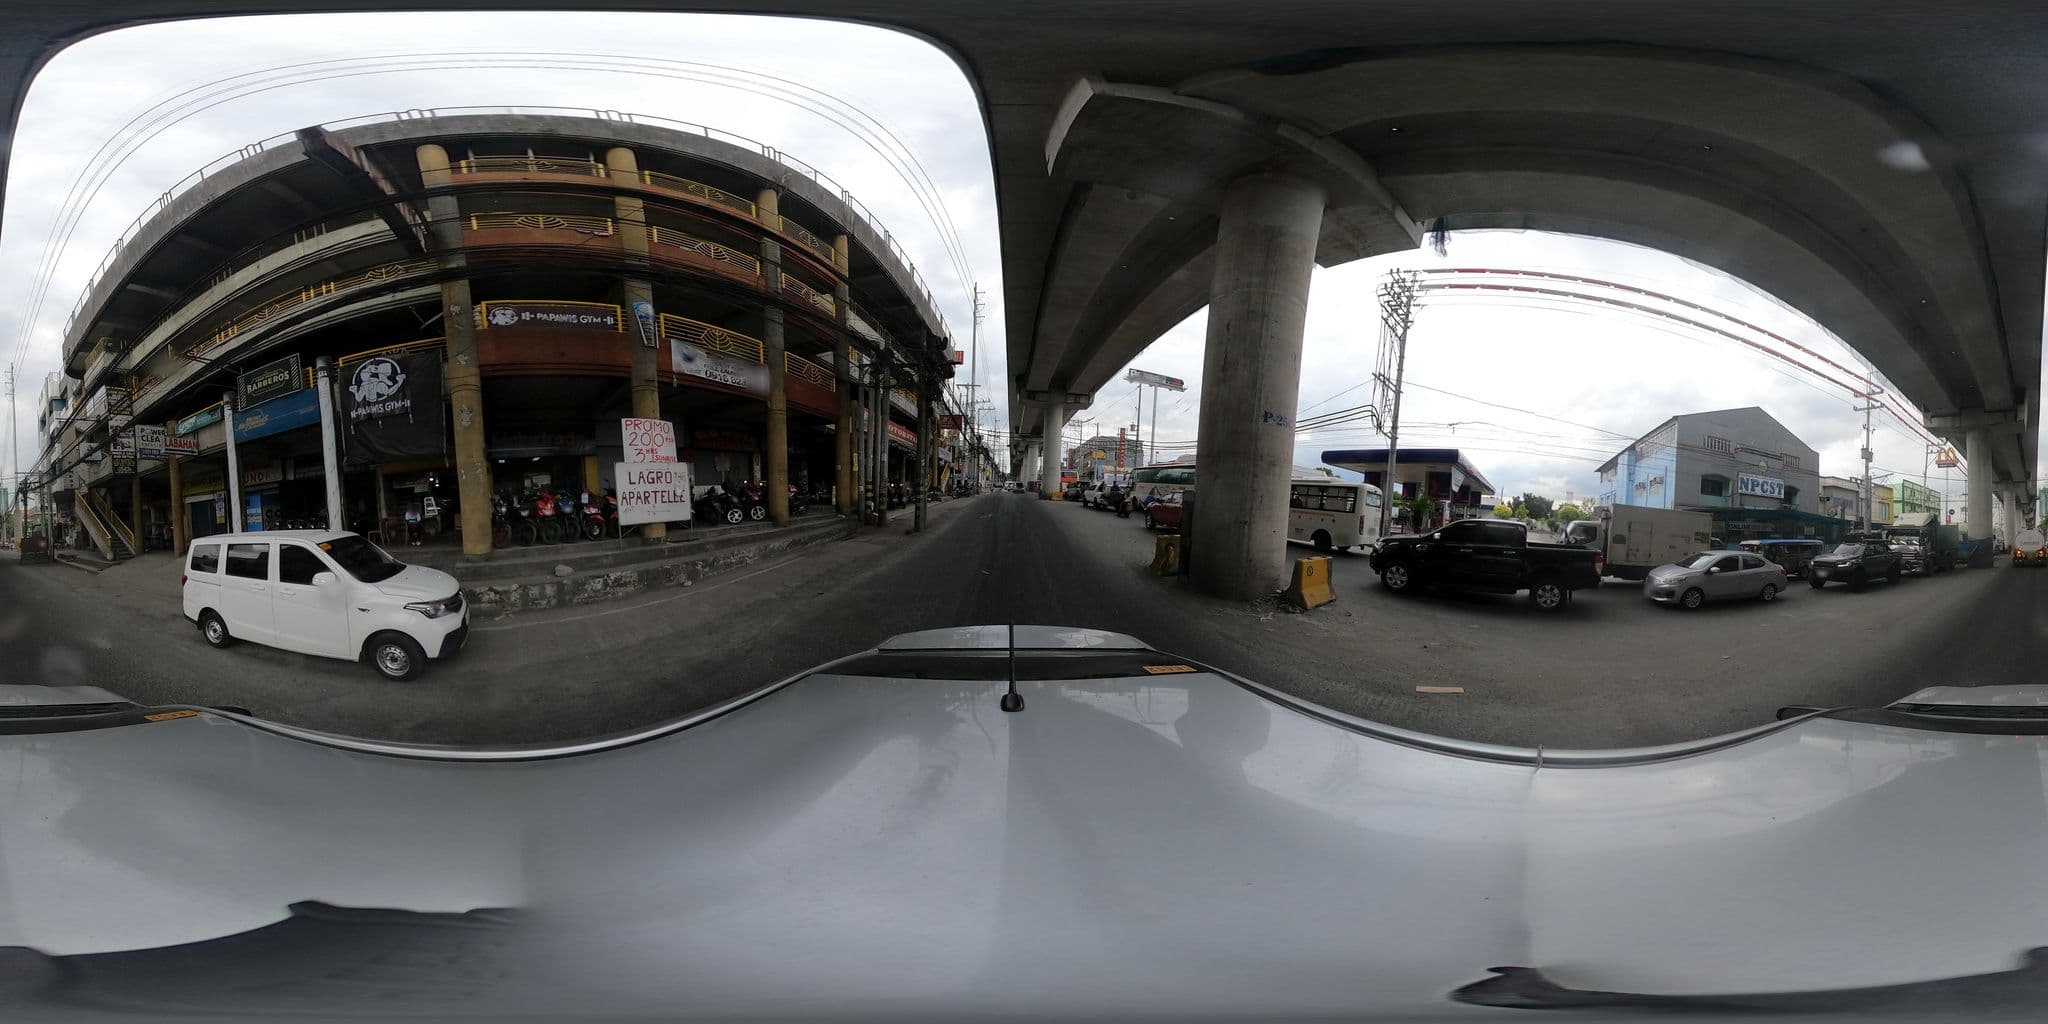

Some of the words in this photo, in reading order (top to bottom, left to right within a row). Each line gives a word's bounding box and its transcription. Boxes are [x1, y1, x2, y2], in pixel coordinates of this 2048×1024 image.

[580, 315, 601, 323] GYM
[247, 371, 289, 394] BARBEROS
[385, 400, 401, 411] GYM
[625, 420, 670, 433] PROMO
[141, 434, 162, 443] CLEA
[164, 438, 199, 449] LABAHAN
[629, 431, 664, 447] 200
[634, 449, 646, 463] 3
[628, 471, 673, 485] LAGRO
[1739, 476, 1784, 496] NPCST
